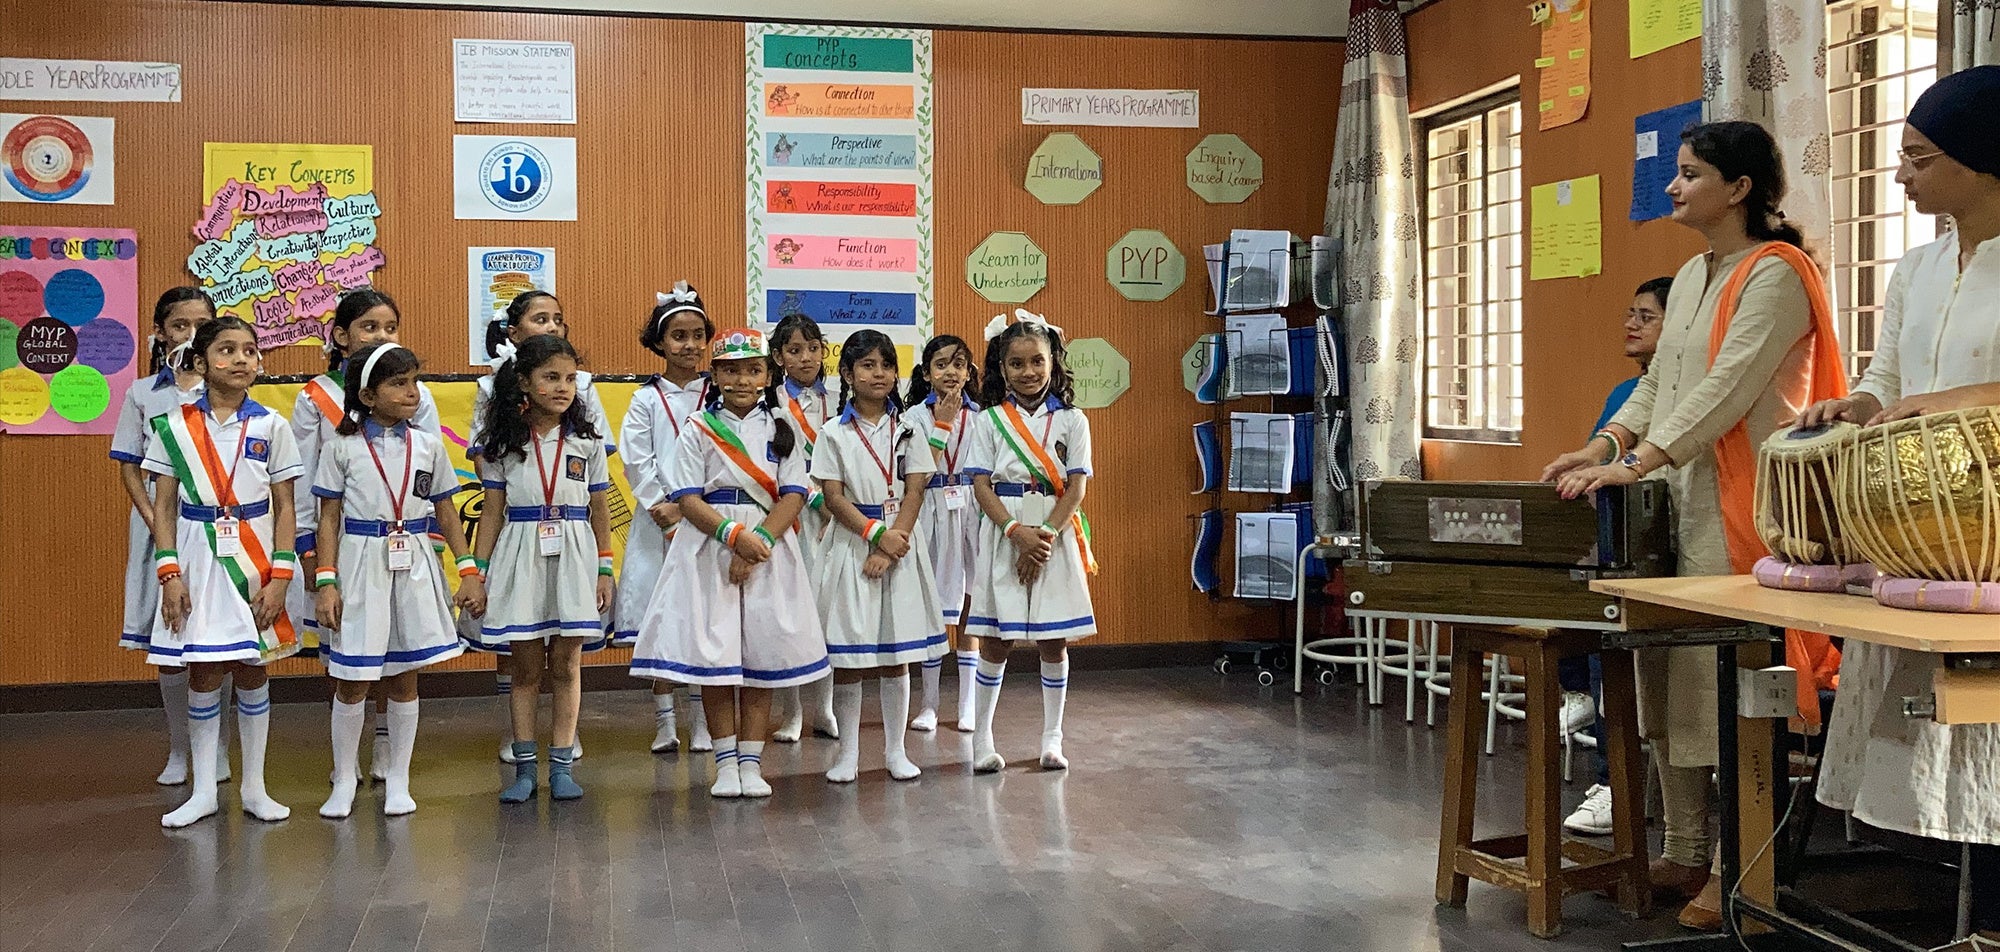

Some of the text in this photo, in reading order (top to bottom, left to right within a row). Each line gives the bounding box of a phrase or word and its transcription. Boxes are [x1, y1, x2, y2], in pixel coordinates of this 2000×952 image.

[461, 45, 570, 58] IB MISSION STATEMENT
[818, 38, 839, 52] PYP
[825, 86, 875, 101] Connection
[795, 103, 814, 116] How
[1031, 93, 1081, 115] PRIMARY
[831, 136, 883, 152] Perspective
[801, 150, 826, 166] What
[829, 156, 840, 166] are
[845, 153, 856, 166] the
[860, 153, 885, 167] points
[1195, 146, 1246, 173] Inquiry
[245, 159, 356, 185] KEY CONCEPTS
[1031, 154, 1102, 181] International
[1191, 168, 1224, 184] based
[243, 187, 325, 213] Development
[817, 184, 882, 200] Responsibility
[327, 200, 376, 219] Culture
[806, 200, 831, 212] What
[319, 225, 372, 248] Perspective
[50, 238, 124, 257] CONTEXT
[268, 232, 321, 259] Creativity
[838, 239, 888, 255] Function
[195, 242, 223, 275] Global
[822, 257, 842, 268] How
[846, 257, 864, 268] does
[864, 256, 873, 268] it
[977, 244, 1043, 268] Learn for
[1121, 246, 1168, 280] PYP
[349, 259, 368, 273] place
[487, 261, 539, 270] ATTRIBUTES
[212, 273, 269, 304] onnections
[849, 294, 873, 307] Form
[257, 302, 290, 322] Logic
[830, 308, 856, 320] What
[31, 325, 67, 341] MYP
[256, 323, 321, 346] ommunication
[23, 339, 68, 349] GLOBAL
[26, 353, 70, 364] CONTEXT
